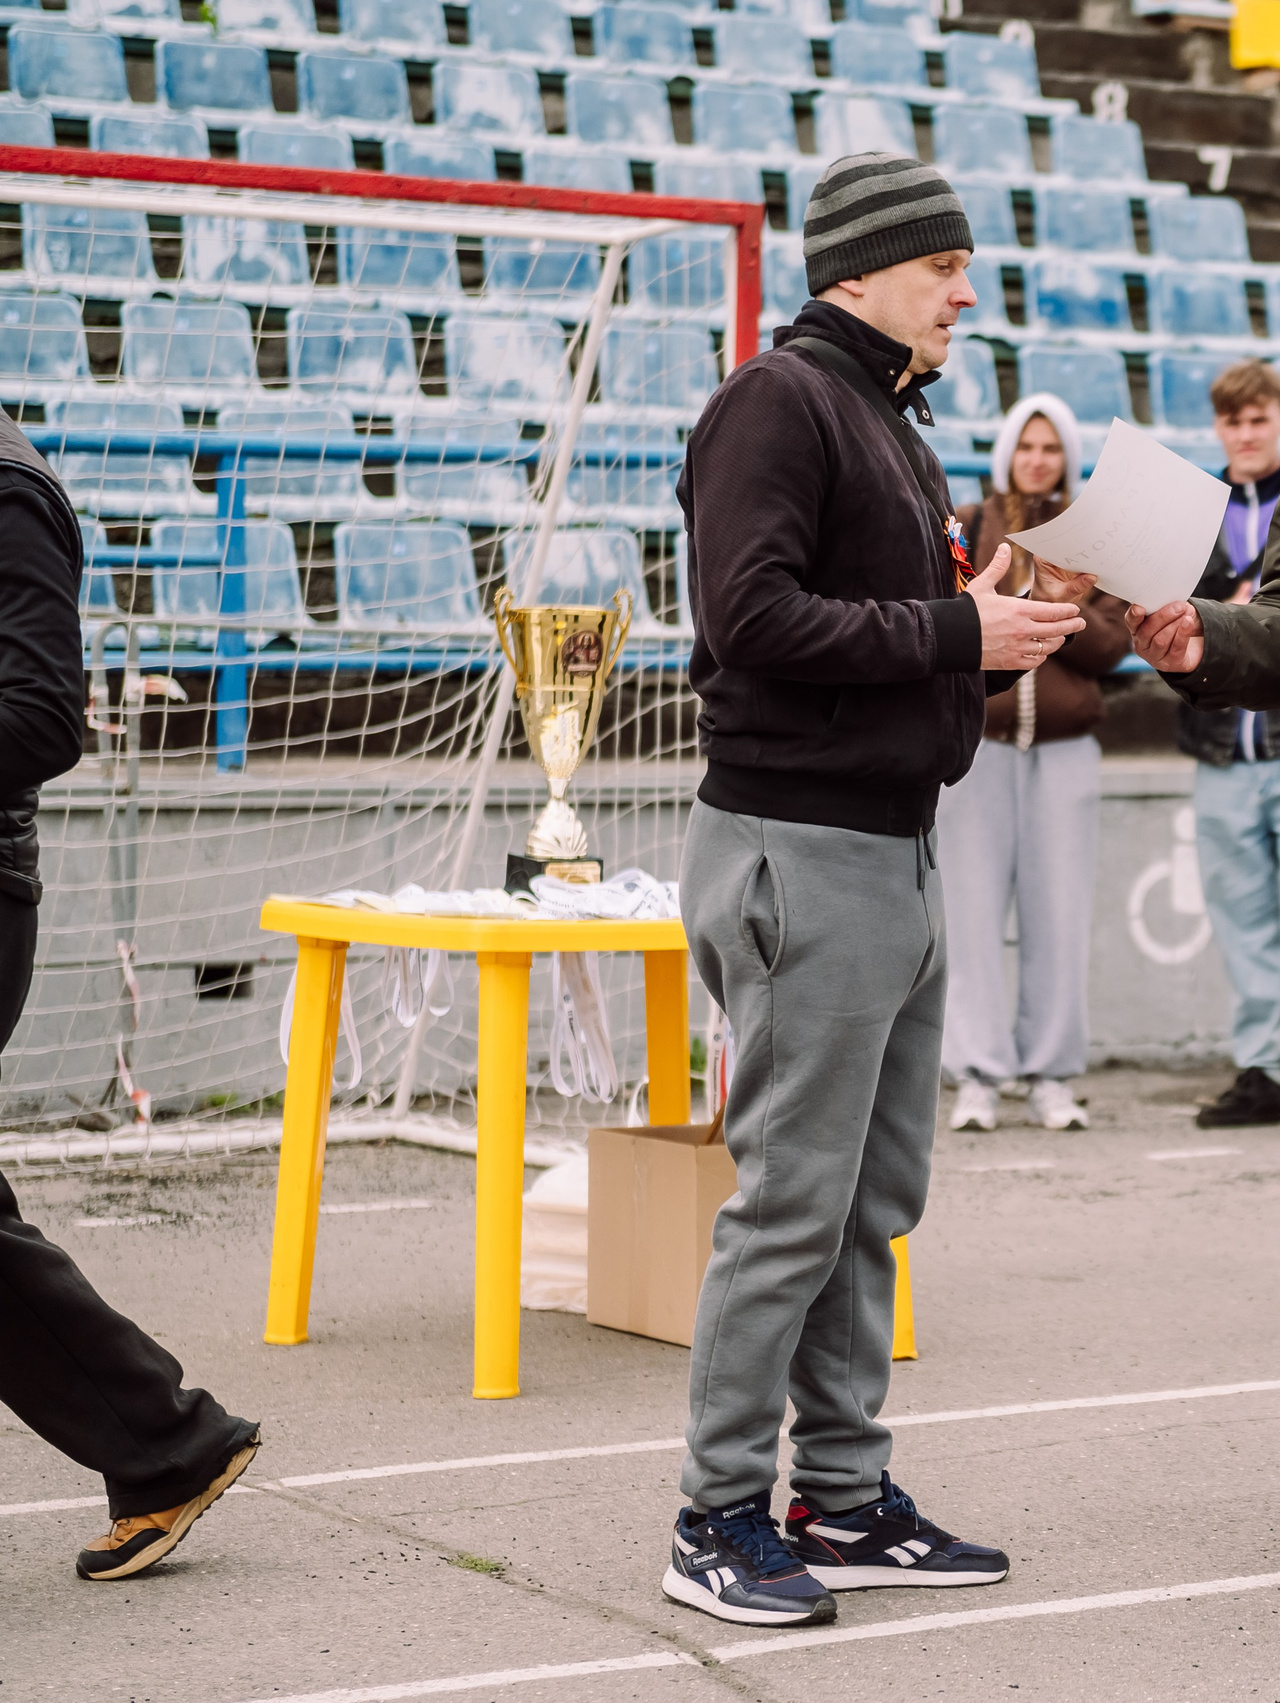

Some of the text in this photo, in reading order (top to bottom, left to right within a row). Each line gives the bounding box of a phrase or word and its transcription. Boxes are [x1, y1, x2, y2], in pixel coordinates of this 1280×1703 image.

[1091, 81, 1129, 123] 8
[1197, 147, 1233, 192] 7
[692, 1551, 718, 1566] Reebok
